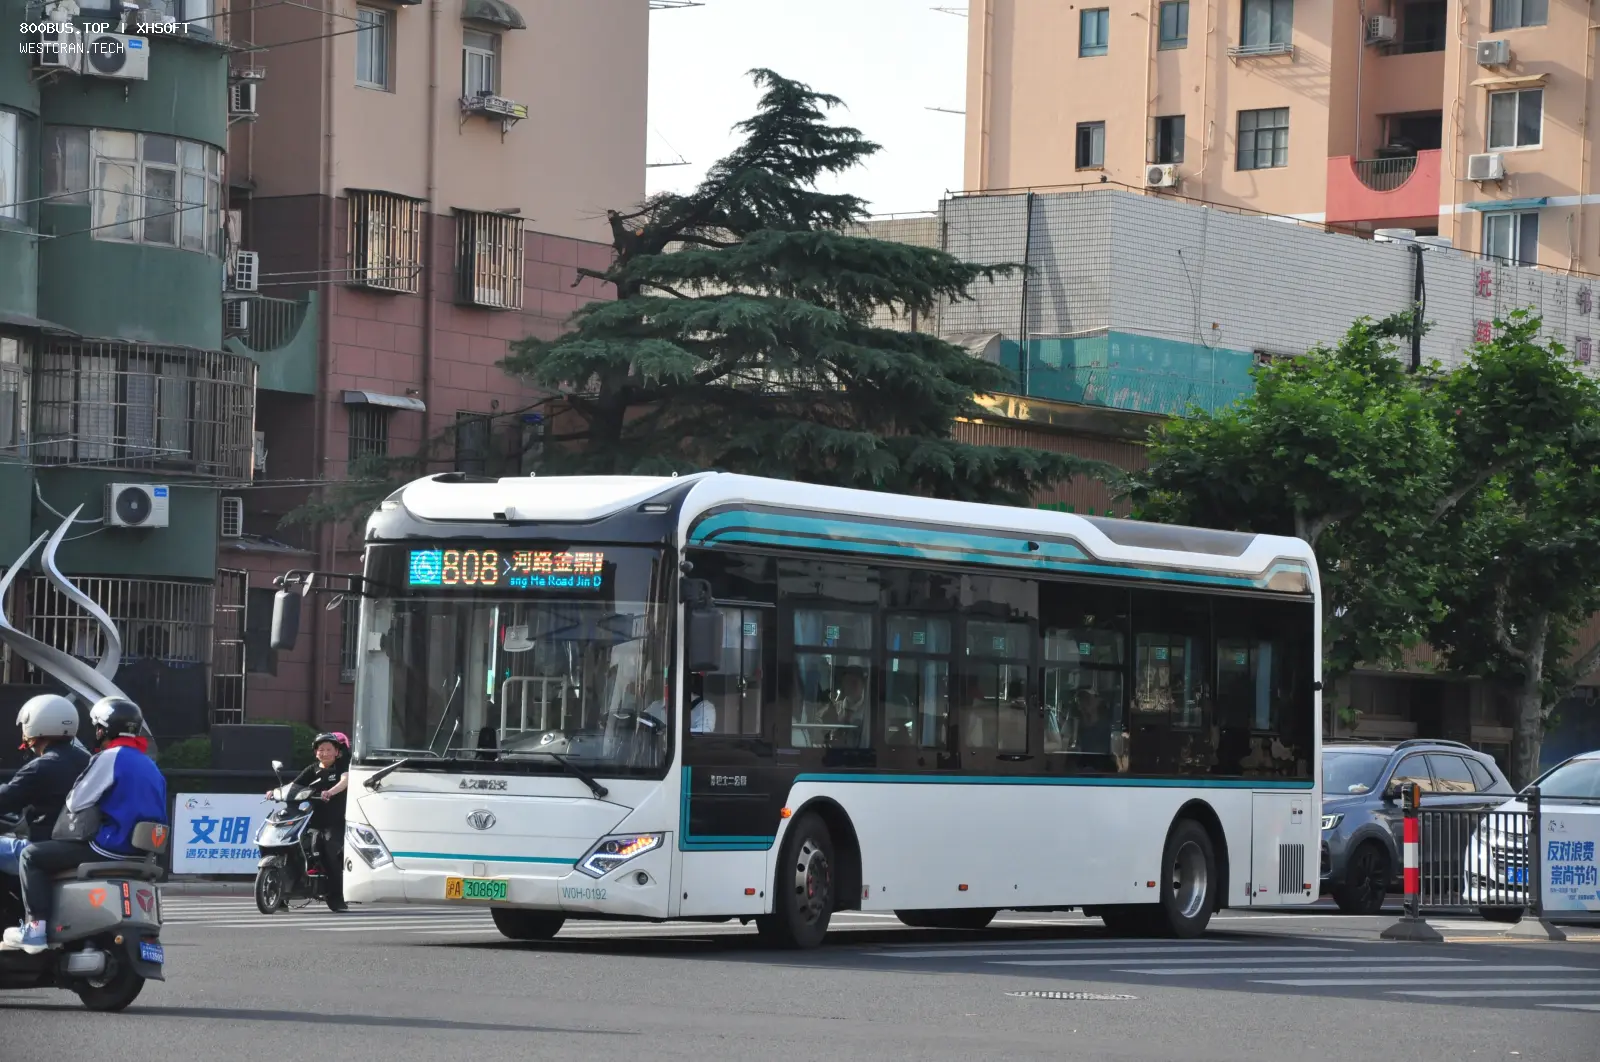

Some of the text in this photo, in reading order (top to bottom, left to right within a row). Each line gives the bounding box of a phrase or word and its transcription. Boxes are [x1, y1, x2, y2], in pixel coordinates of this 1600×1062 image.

[442, 550, 498, 585] 808
[548, 576, 574, 587] Road
[576, 576, 590, 587] Jin
[188, 815, 251, 845] 文明
[1548, 840, 1595, 861] 反对浪费
[1551, 865, 1597, 886] 崇尚节约
